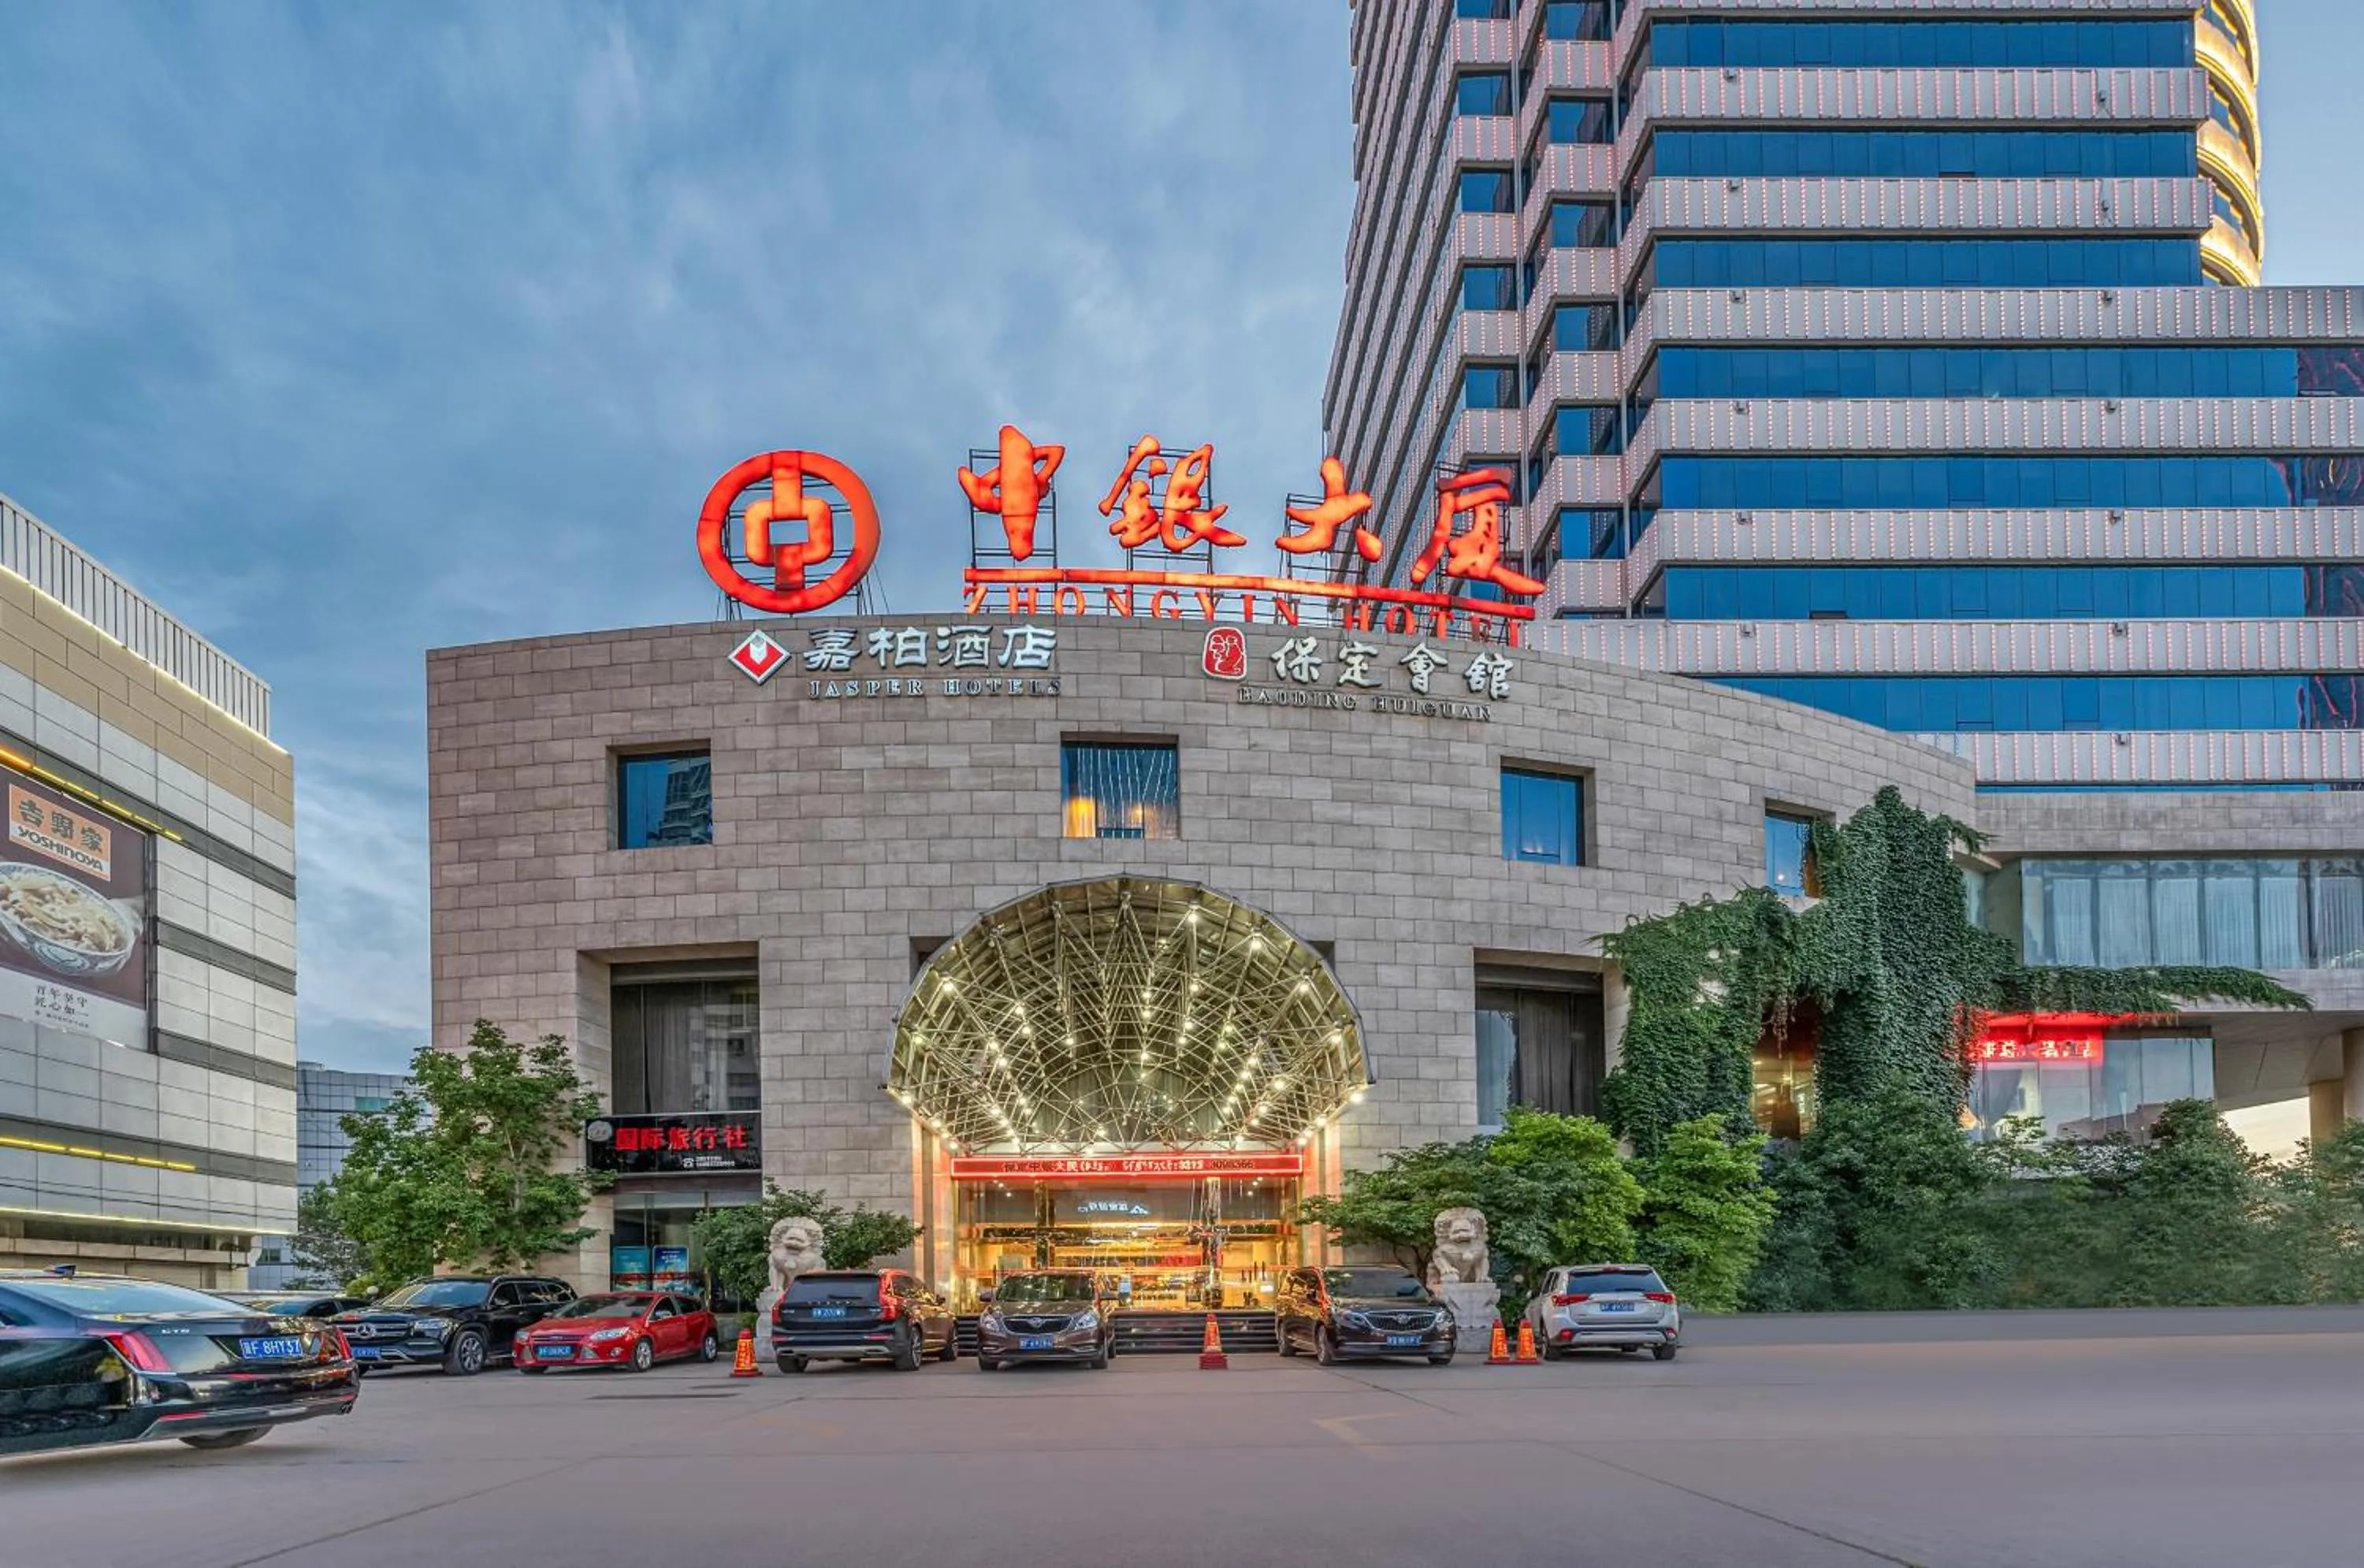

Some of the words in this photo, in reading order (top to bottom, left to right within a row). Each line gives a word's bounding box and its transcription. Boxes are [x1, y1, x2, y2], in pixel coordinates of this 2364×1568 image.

[962, 585, 1300, 626] ZHONGYIN
[804, 624, 1057, 672] 嘉柏酒店
[1270, 635, 1514, 700] 保定會館
[808, 679, 924, 699] JASPER
[943, 678, 1061, 697] HOTELS
[1237, 686, 1357, 711] BAODING
[1371, 696, 1492, 722] HUIGUAN
[615, 1124, 748, 1151] 国际旅行社
